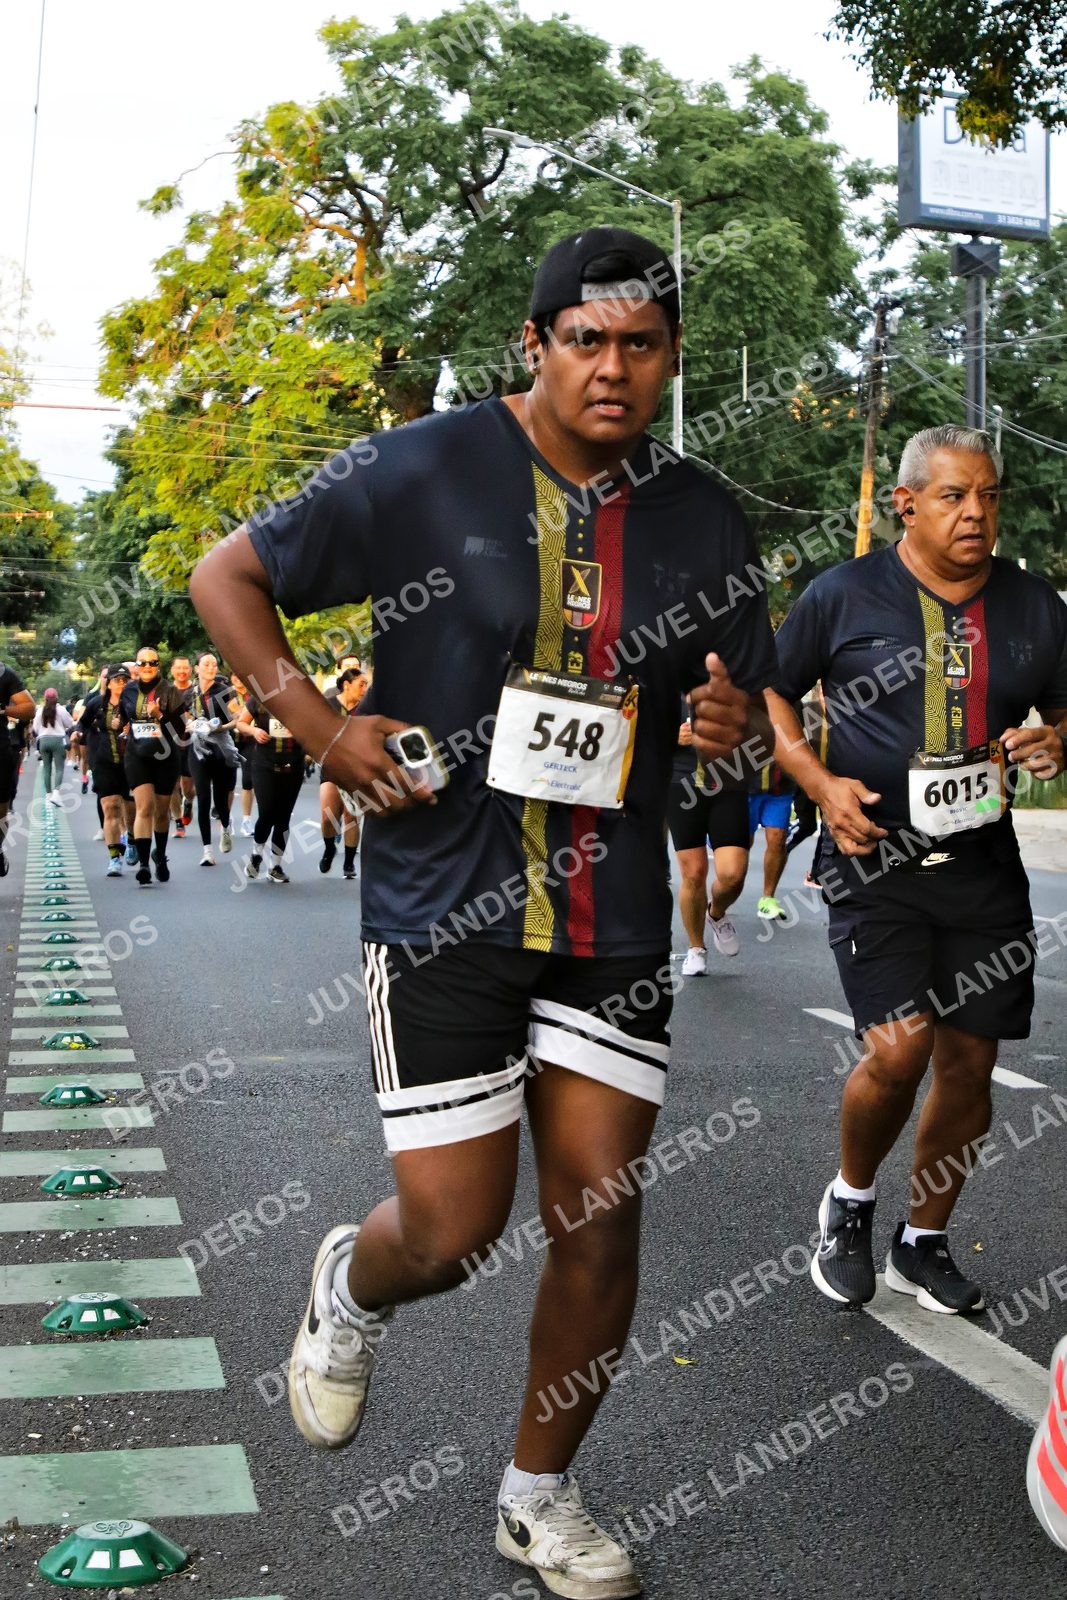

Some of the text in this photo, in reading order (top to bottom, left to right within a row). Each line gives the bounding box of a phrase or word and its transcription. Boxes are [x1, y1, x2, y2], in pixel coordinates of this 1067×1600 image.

[558, 678, 588, 691] NEGROS
[527, 711, 604, 761] 548
[924, 771, 989, 808] 6015
[927, 853, 951, 861] NIKE
